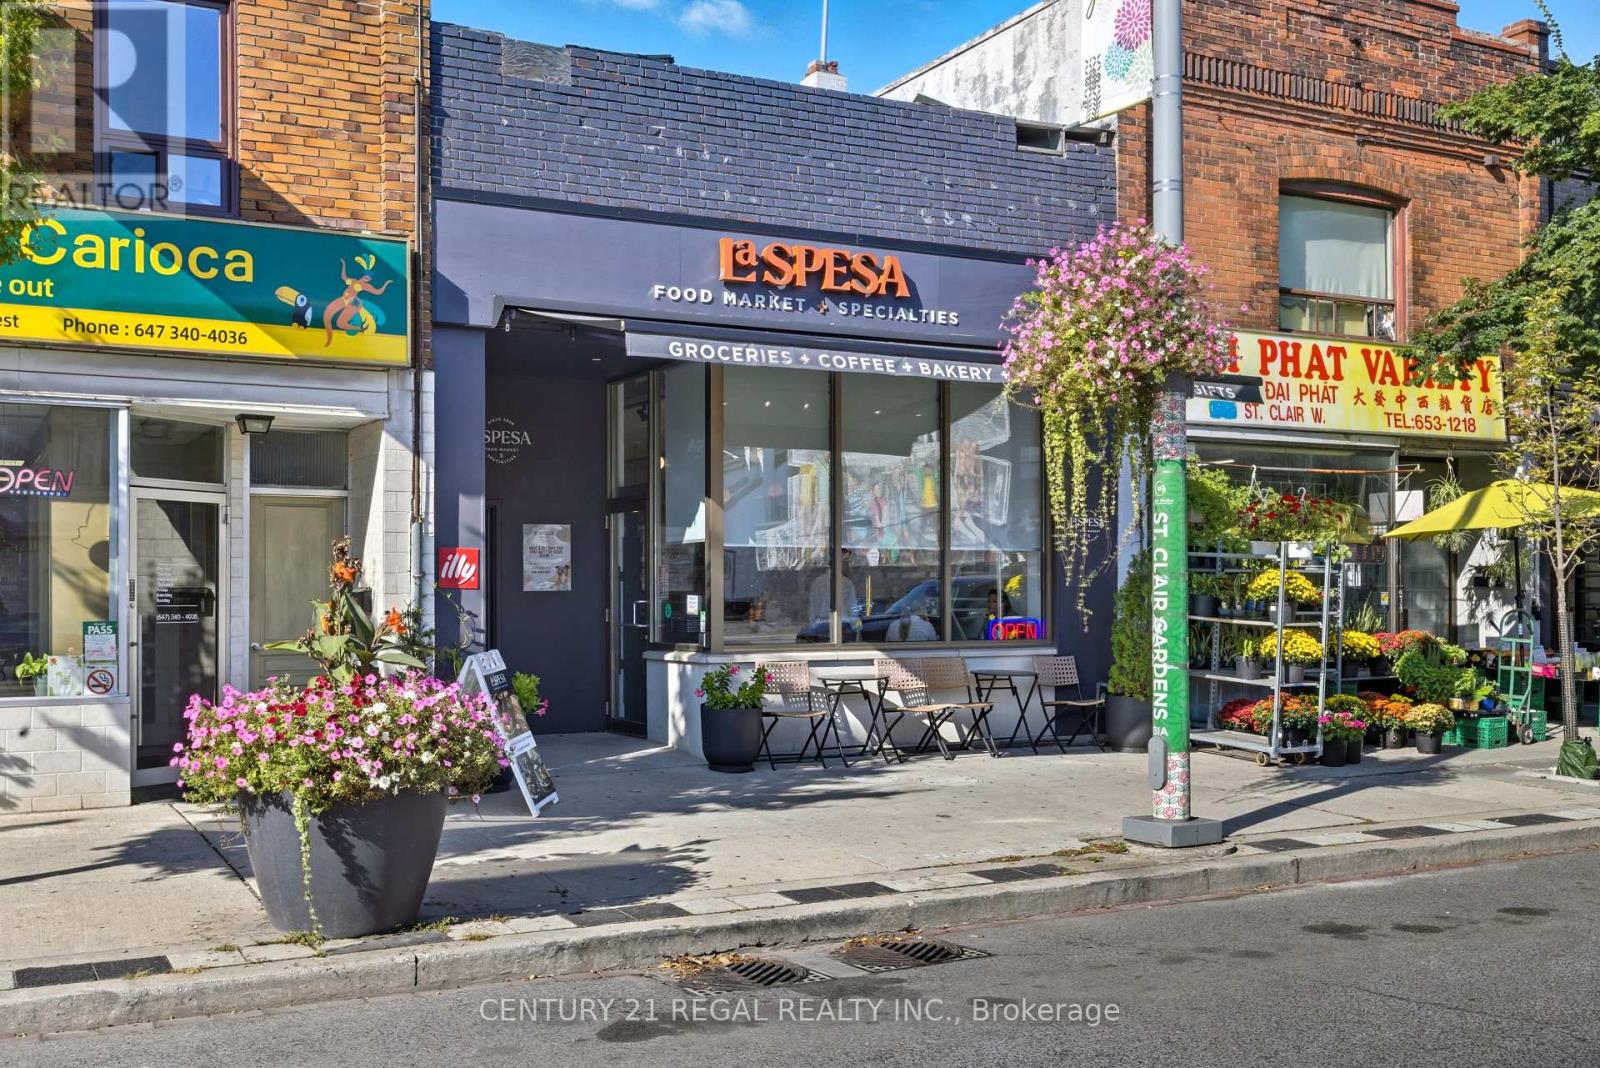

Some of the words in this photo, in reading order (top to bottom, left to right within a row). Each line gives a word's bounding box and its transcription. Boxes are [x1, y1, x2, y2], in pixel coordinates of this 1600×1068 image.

[20, 218, 253, 282] Carioca
[718, 237, 759, 283] La
[761, 241, 911, 298] SPESA
[8, 278, 54, 298] out
[653, 284, 713, 304] FOOD
[722, 290, 806, 312] MARKET
[838, 301, 960, 326] SPECIALTIES
[63, 317, 119, 336] Phone
[134, 323, 165, 339] 647
[170, 325, 247, 345] 340-4036
[669, 341, 793, 365] GROCERIES
[818, 353, 896, 373] COFFEE
[919, 362, 993, 381] BAKERY
[1257, 338, 1348, 382] PHAT
[1361, 347, 1494, 394] VARY
[1244, 402, 1264, 420] ST.
[1269, 404, 1305, 422] CLAIR
[1311, 407, 1327, 424] W.
[1384, 412, 1477, 433] TEL:653-1218
[1153, 512, 1169, 541] ST.
[441, 553, 477, 585] illy
[1153, 548, 1169, 611] CLAIR
[87, 625, 113, 635] PASS
[991, 622, 1037, 640] OPEN
[1152, 618, 1169, 720] GARDENS
